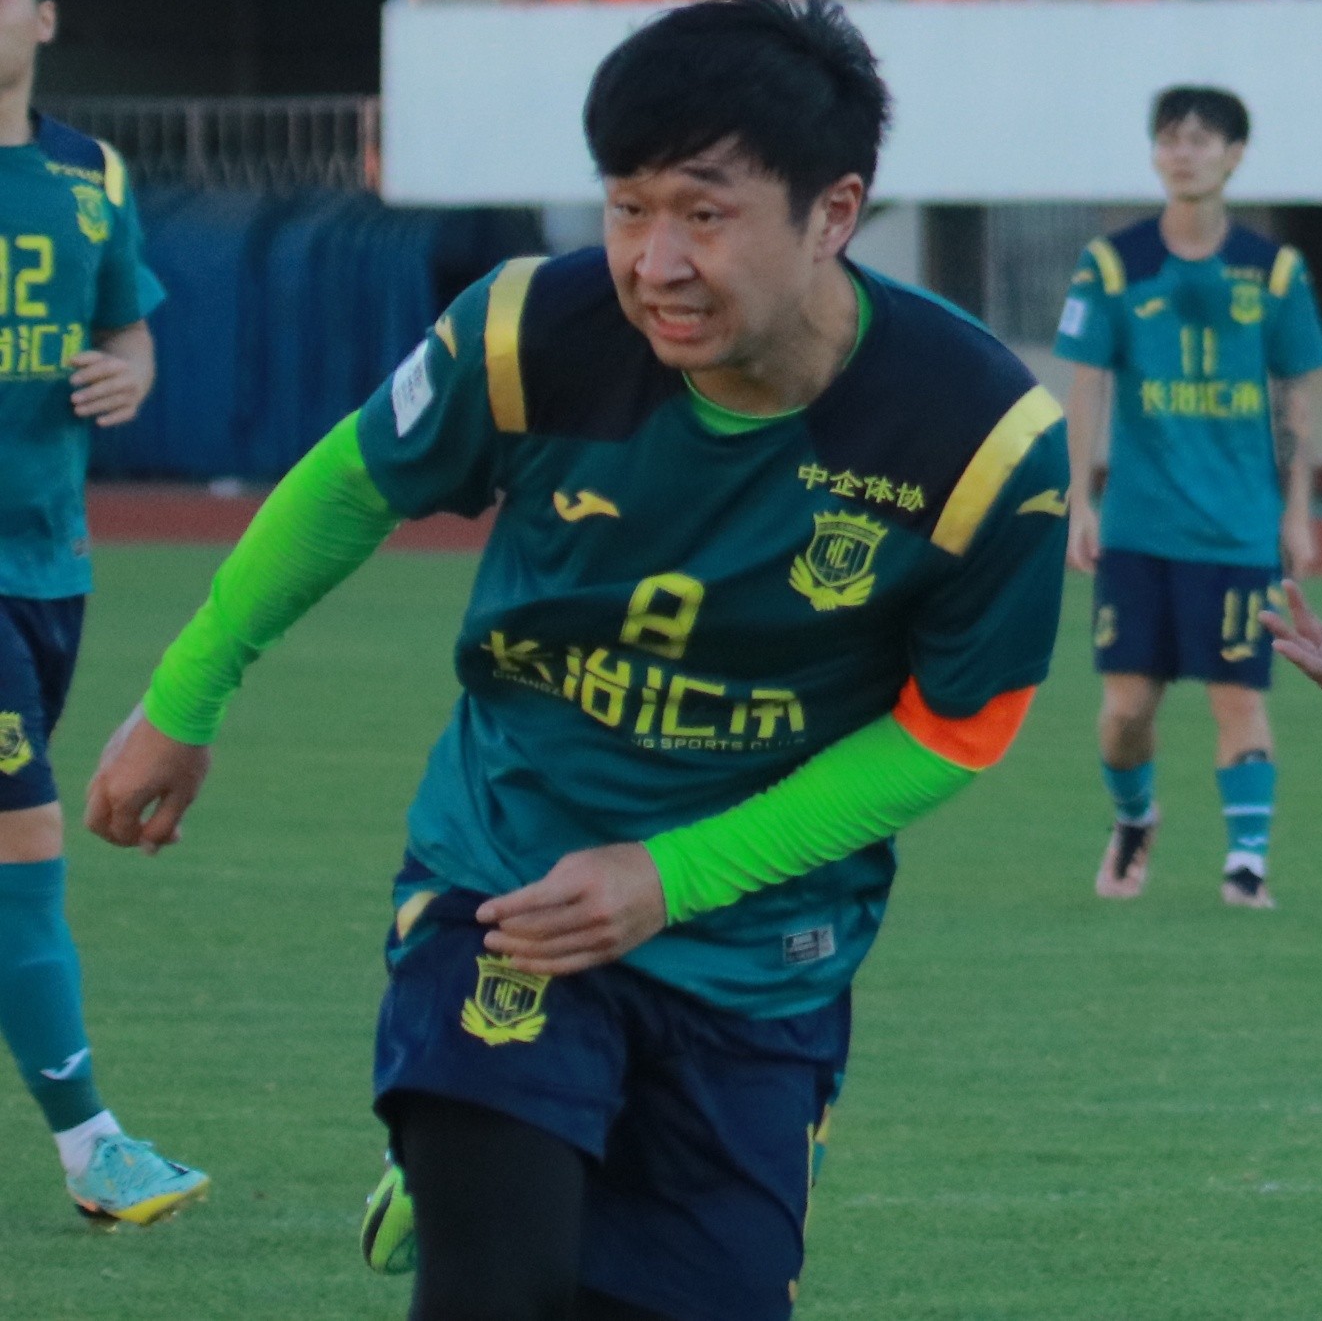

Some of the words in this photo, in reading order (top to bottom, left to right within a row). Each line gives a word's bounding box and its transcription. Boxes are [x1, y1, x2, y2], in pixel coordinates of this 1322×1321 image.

[1180, 326, 1217, 377] 11
[798, 462, 925, 512] 中企体协
[618, 572, 705, 660] 8
